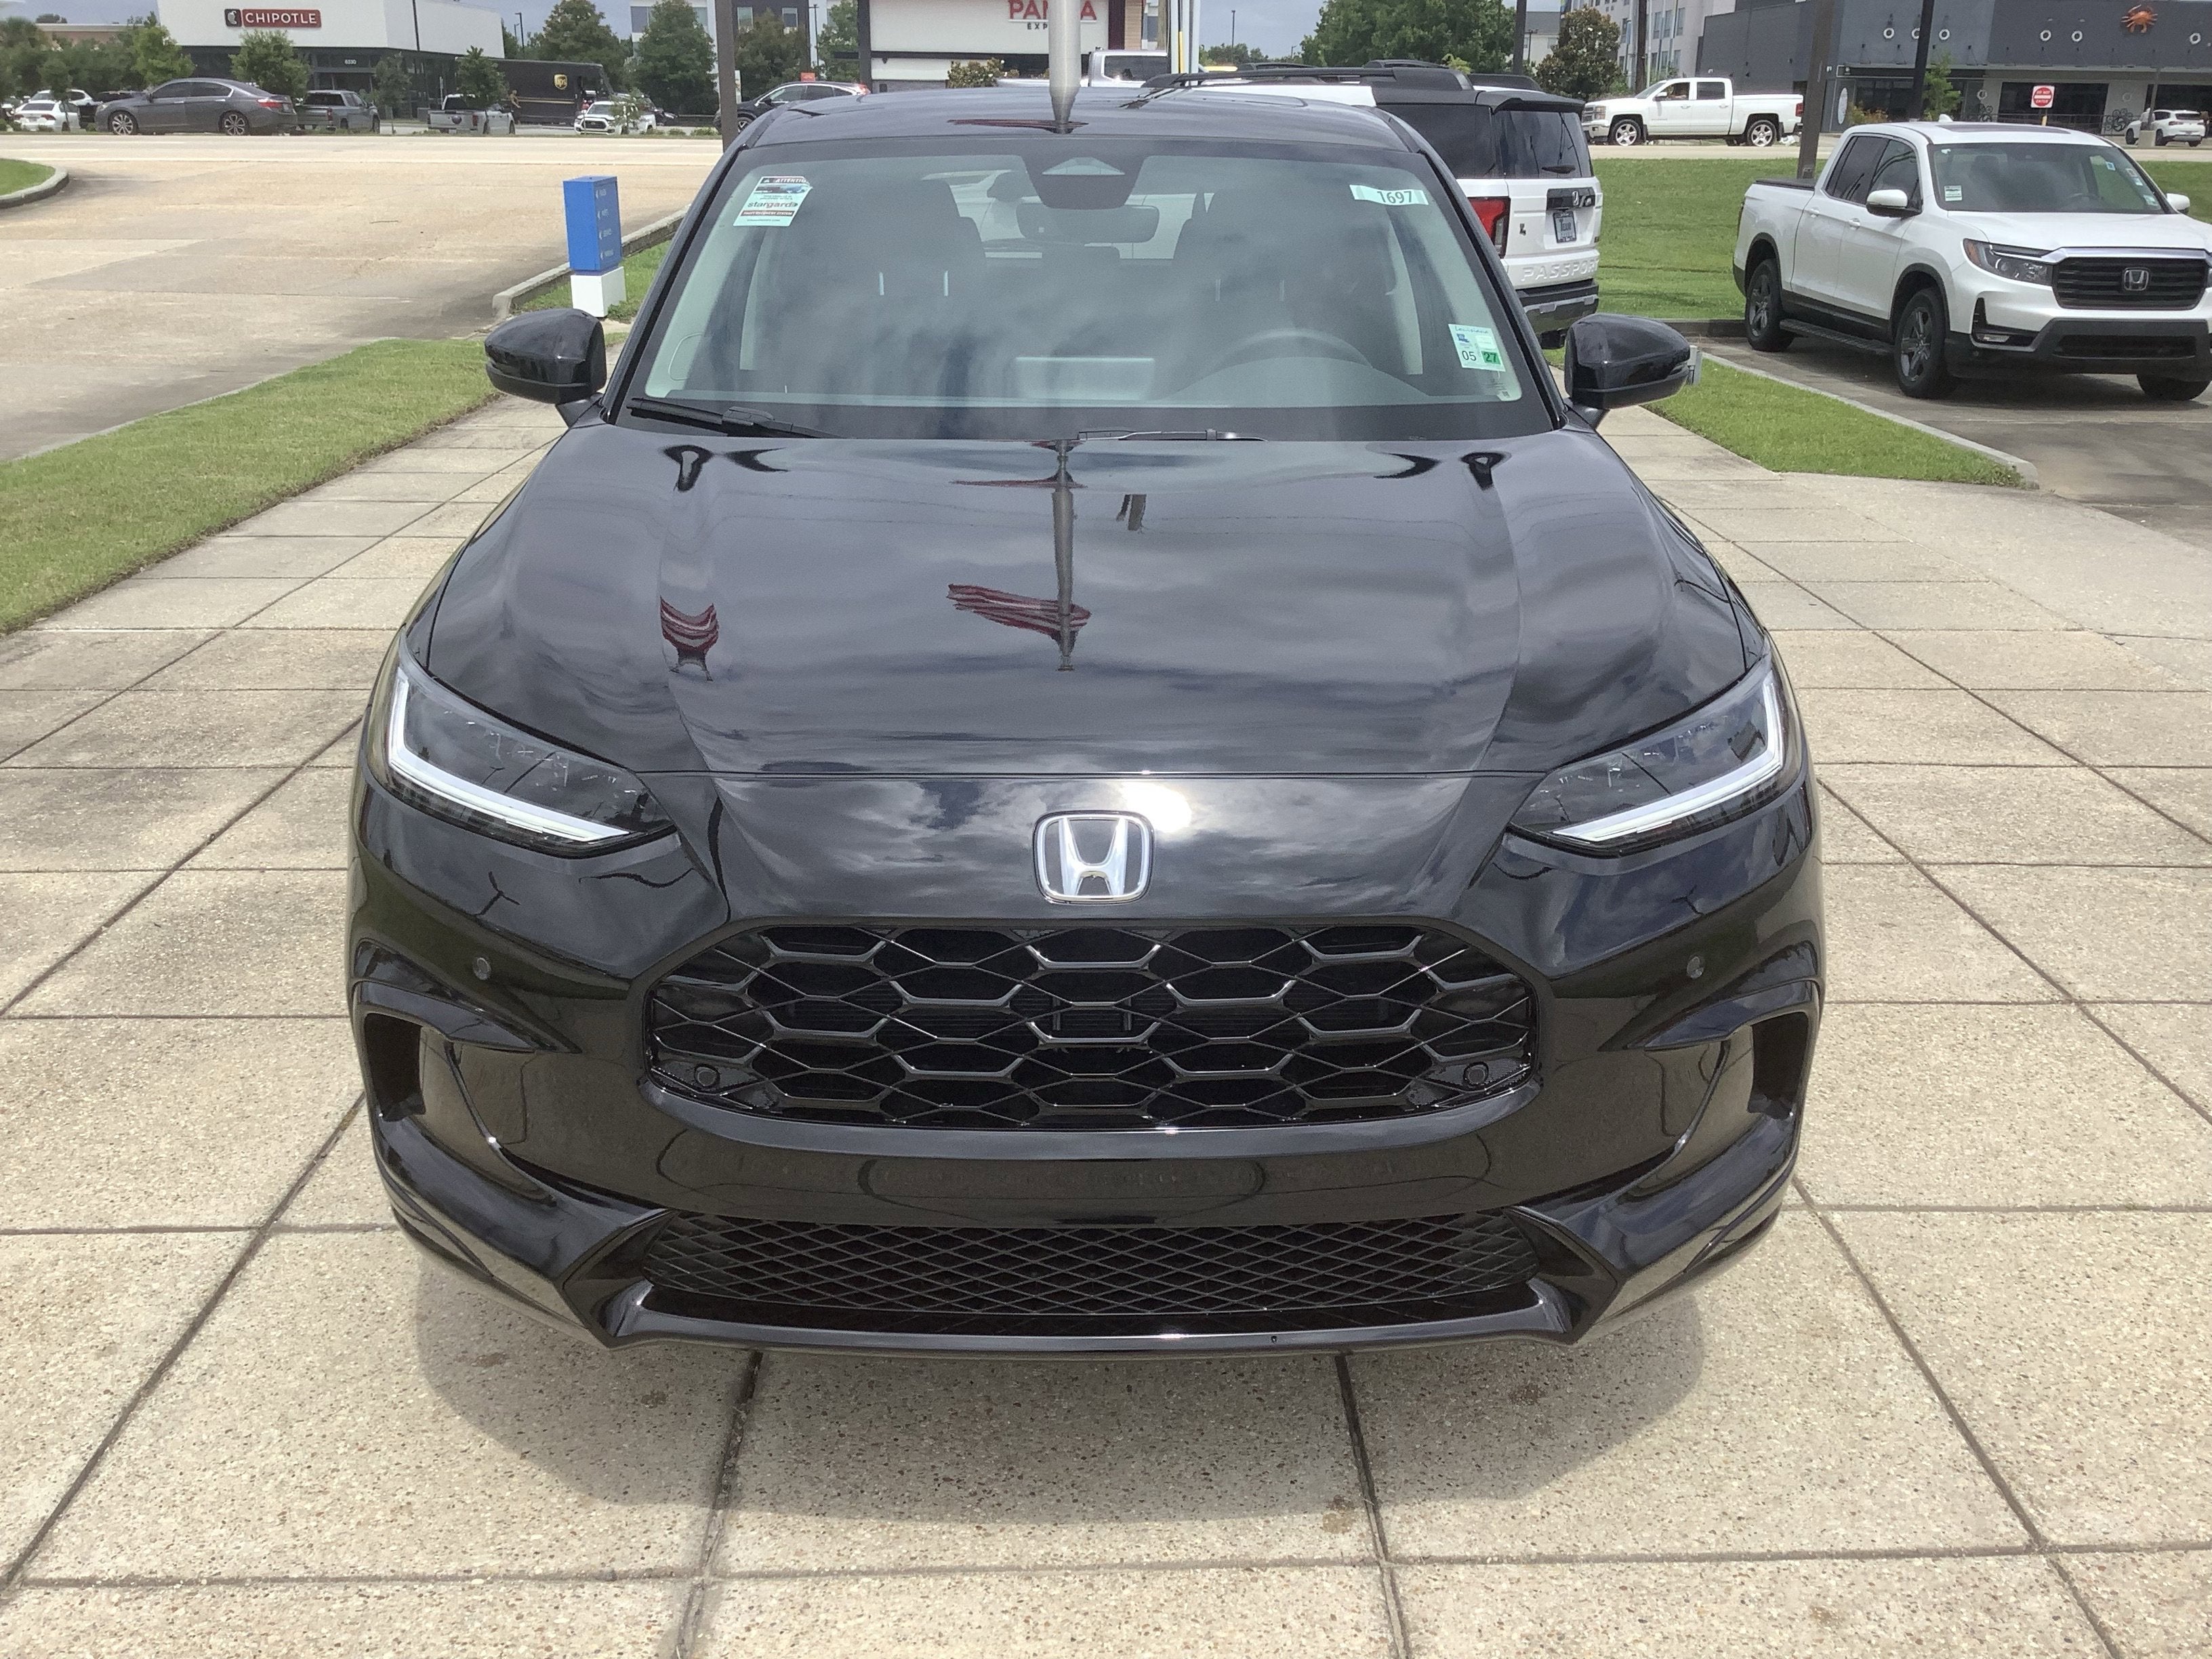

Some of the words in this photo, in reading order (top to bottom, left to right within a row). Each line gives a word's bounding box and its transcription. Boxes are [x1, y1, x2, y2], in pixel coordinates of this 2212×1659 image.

[1008, 0, 1097, 20] PAA
[245, 12, 317, 24] CHIPOTLE
[1376, 190, 1412, 204] 1697
[1520, 259, 1599, 281] PASSPORT
[1462, 350, 1477, 361] 05
[1483, 352, 1497, 363] 27
